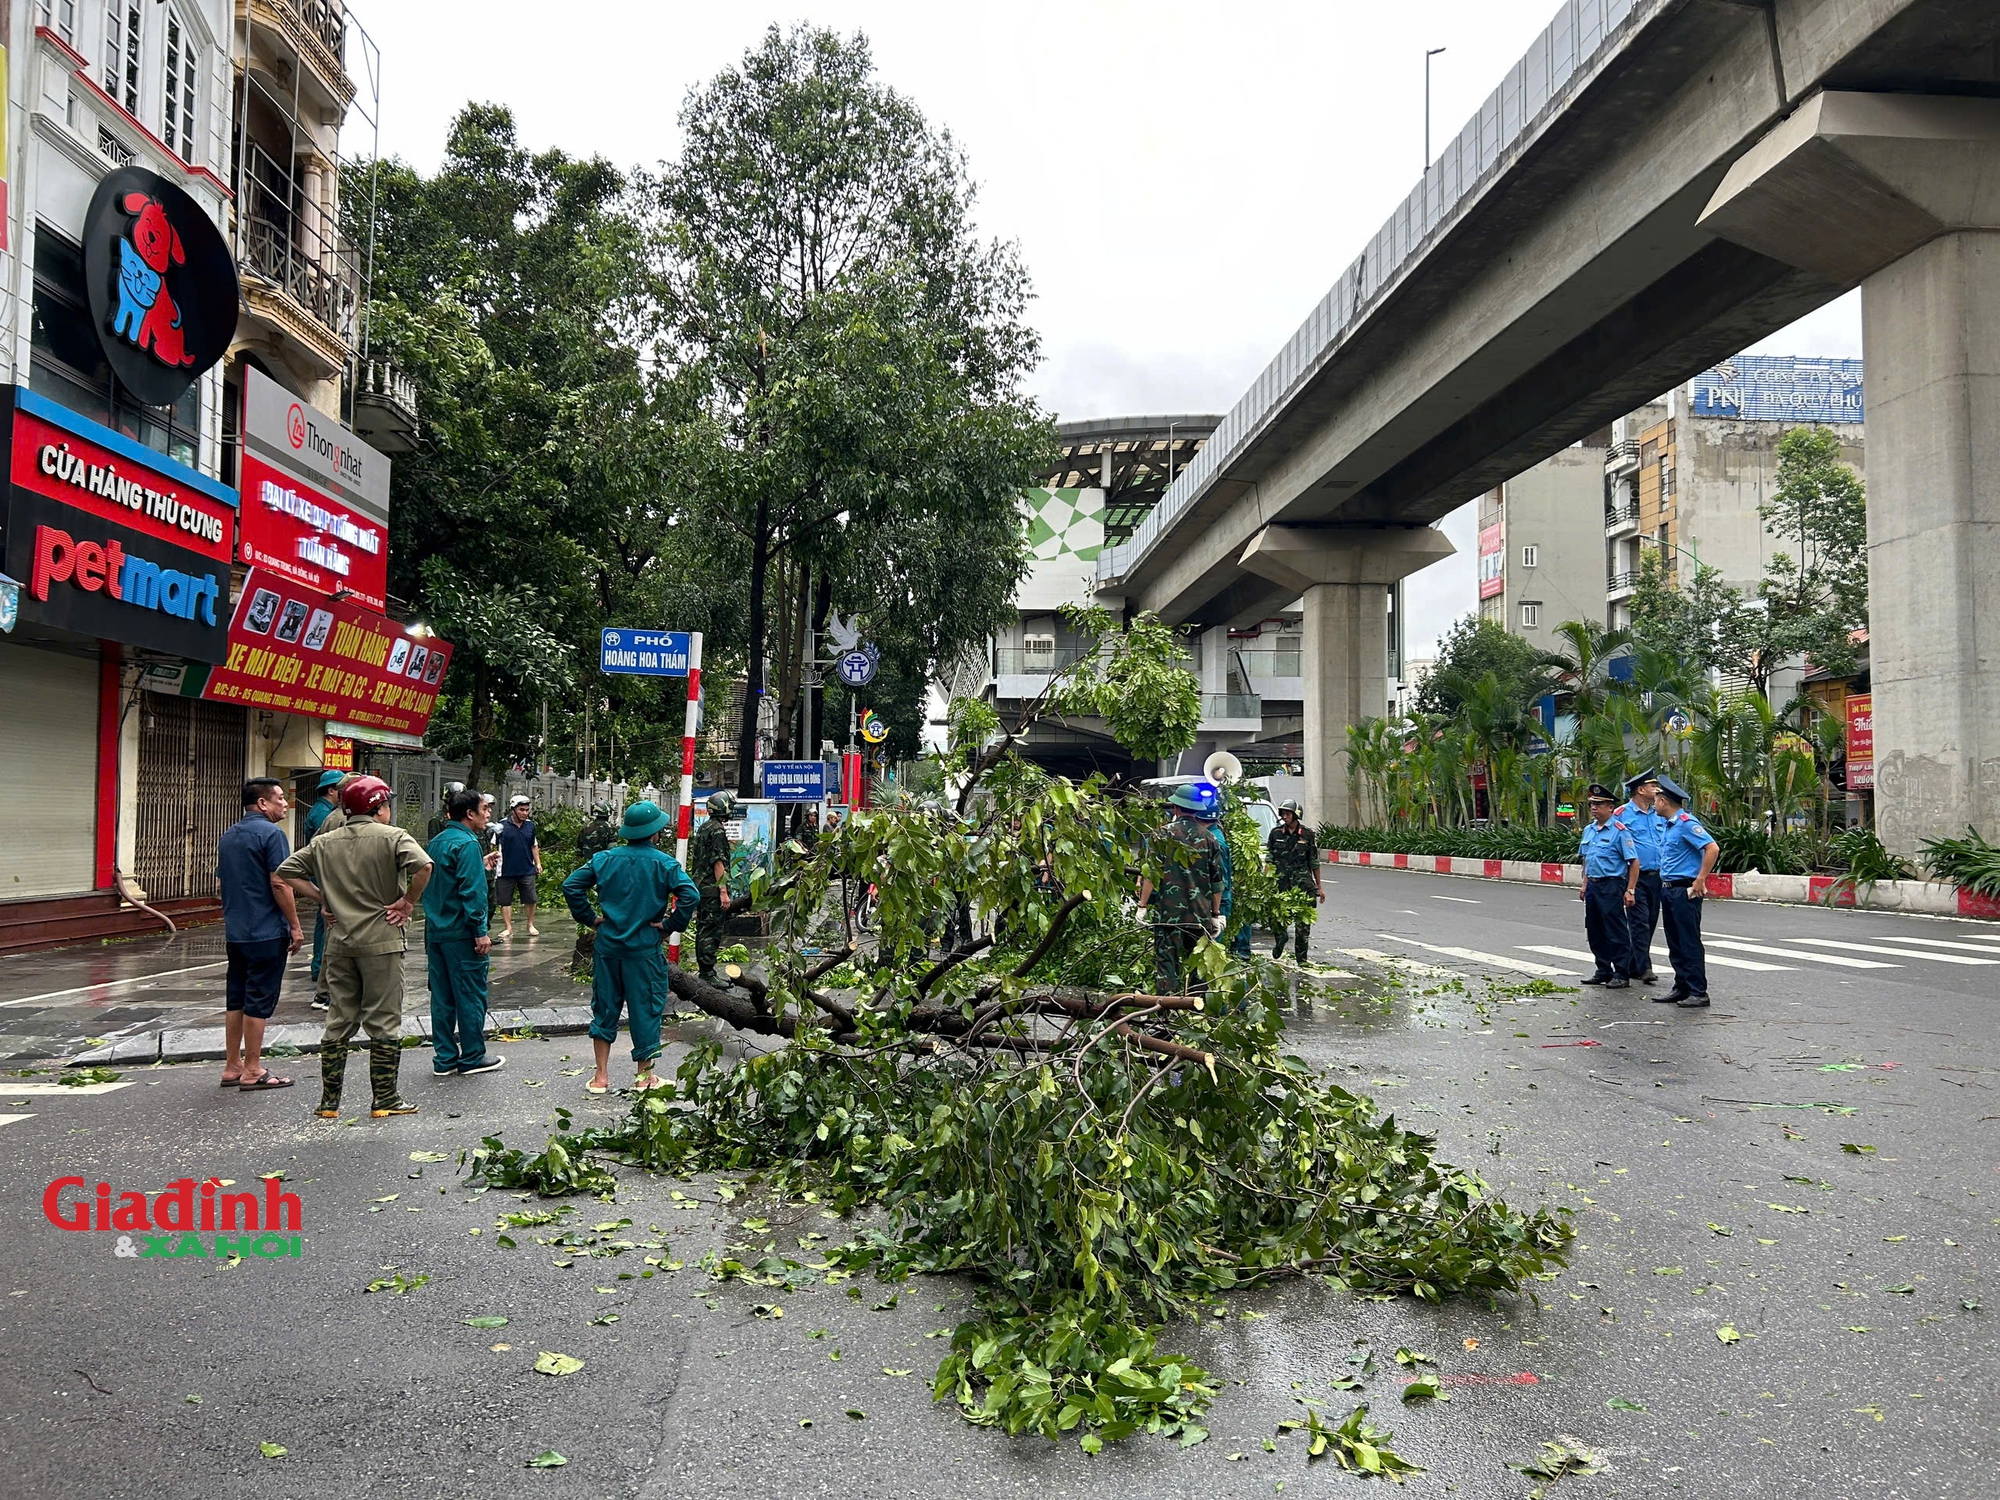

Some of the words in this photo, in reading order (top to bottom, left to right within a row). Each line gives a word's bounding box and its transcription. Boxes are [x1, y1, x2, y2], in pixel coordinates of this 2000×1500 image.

[1707, 386, 1745, 413] PNJ
[306, 421, 362, 478] Thongnhat
[41, 443, 86, 488] CỬA
[89, 465, 143, 510] HÀNG
[145, 489, 178, 525] THÚ
[180, 504, 223, 543] CƯNG
[295, 497, 312, 523] XE
[312, 505, 331, 533] ĐẠP
[358, 528, 380, 555] NHẤT
[298, 536, 325, 568] TUẤN
[31, 525, 219, 627] petmart
[330, 615, 364, 659] TUẤN
[634, 632, 673, 647] PHỐ
[604, 648, 637, 667] HOÀNG
[639, 651, 658, 668] HOA
[660, 649, 687, 670] THÁM
[223, 642, 249, 672] XE
[243, 645, 277, 678] MÁY
[271, 652, 303, 688] ĐIỆN
[304, 663, 324, 690] XE
[319, 664, 346, 694] MÁY
[340, 673, 356, 697] 50
[352, 675, 369, 700] CC
[371, 680, 388, 704] XE
[382, 683, 403, 710] ĐẠP
[399, 685, 418, 711] CÁC
[413, 692, 434, 718] LOẠI
[251, 690, 274, 704] QUANG
[271, 693, 293, 708] TRUNG
[325, 753, 332, 767] XE
